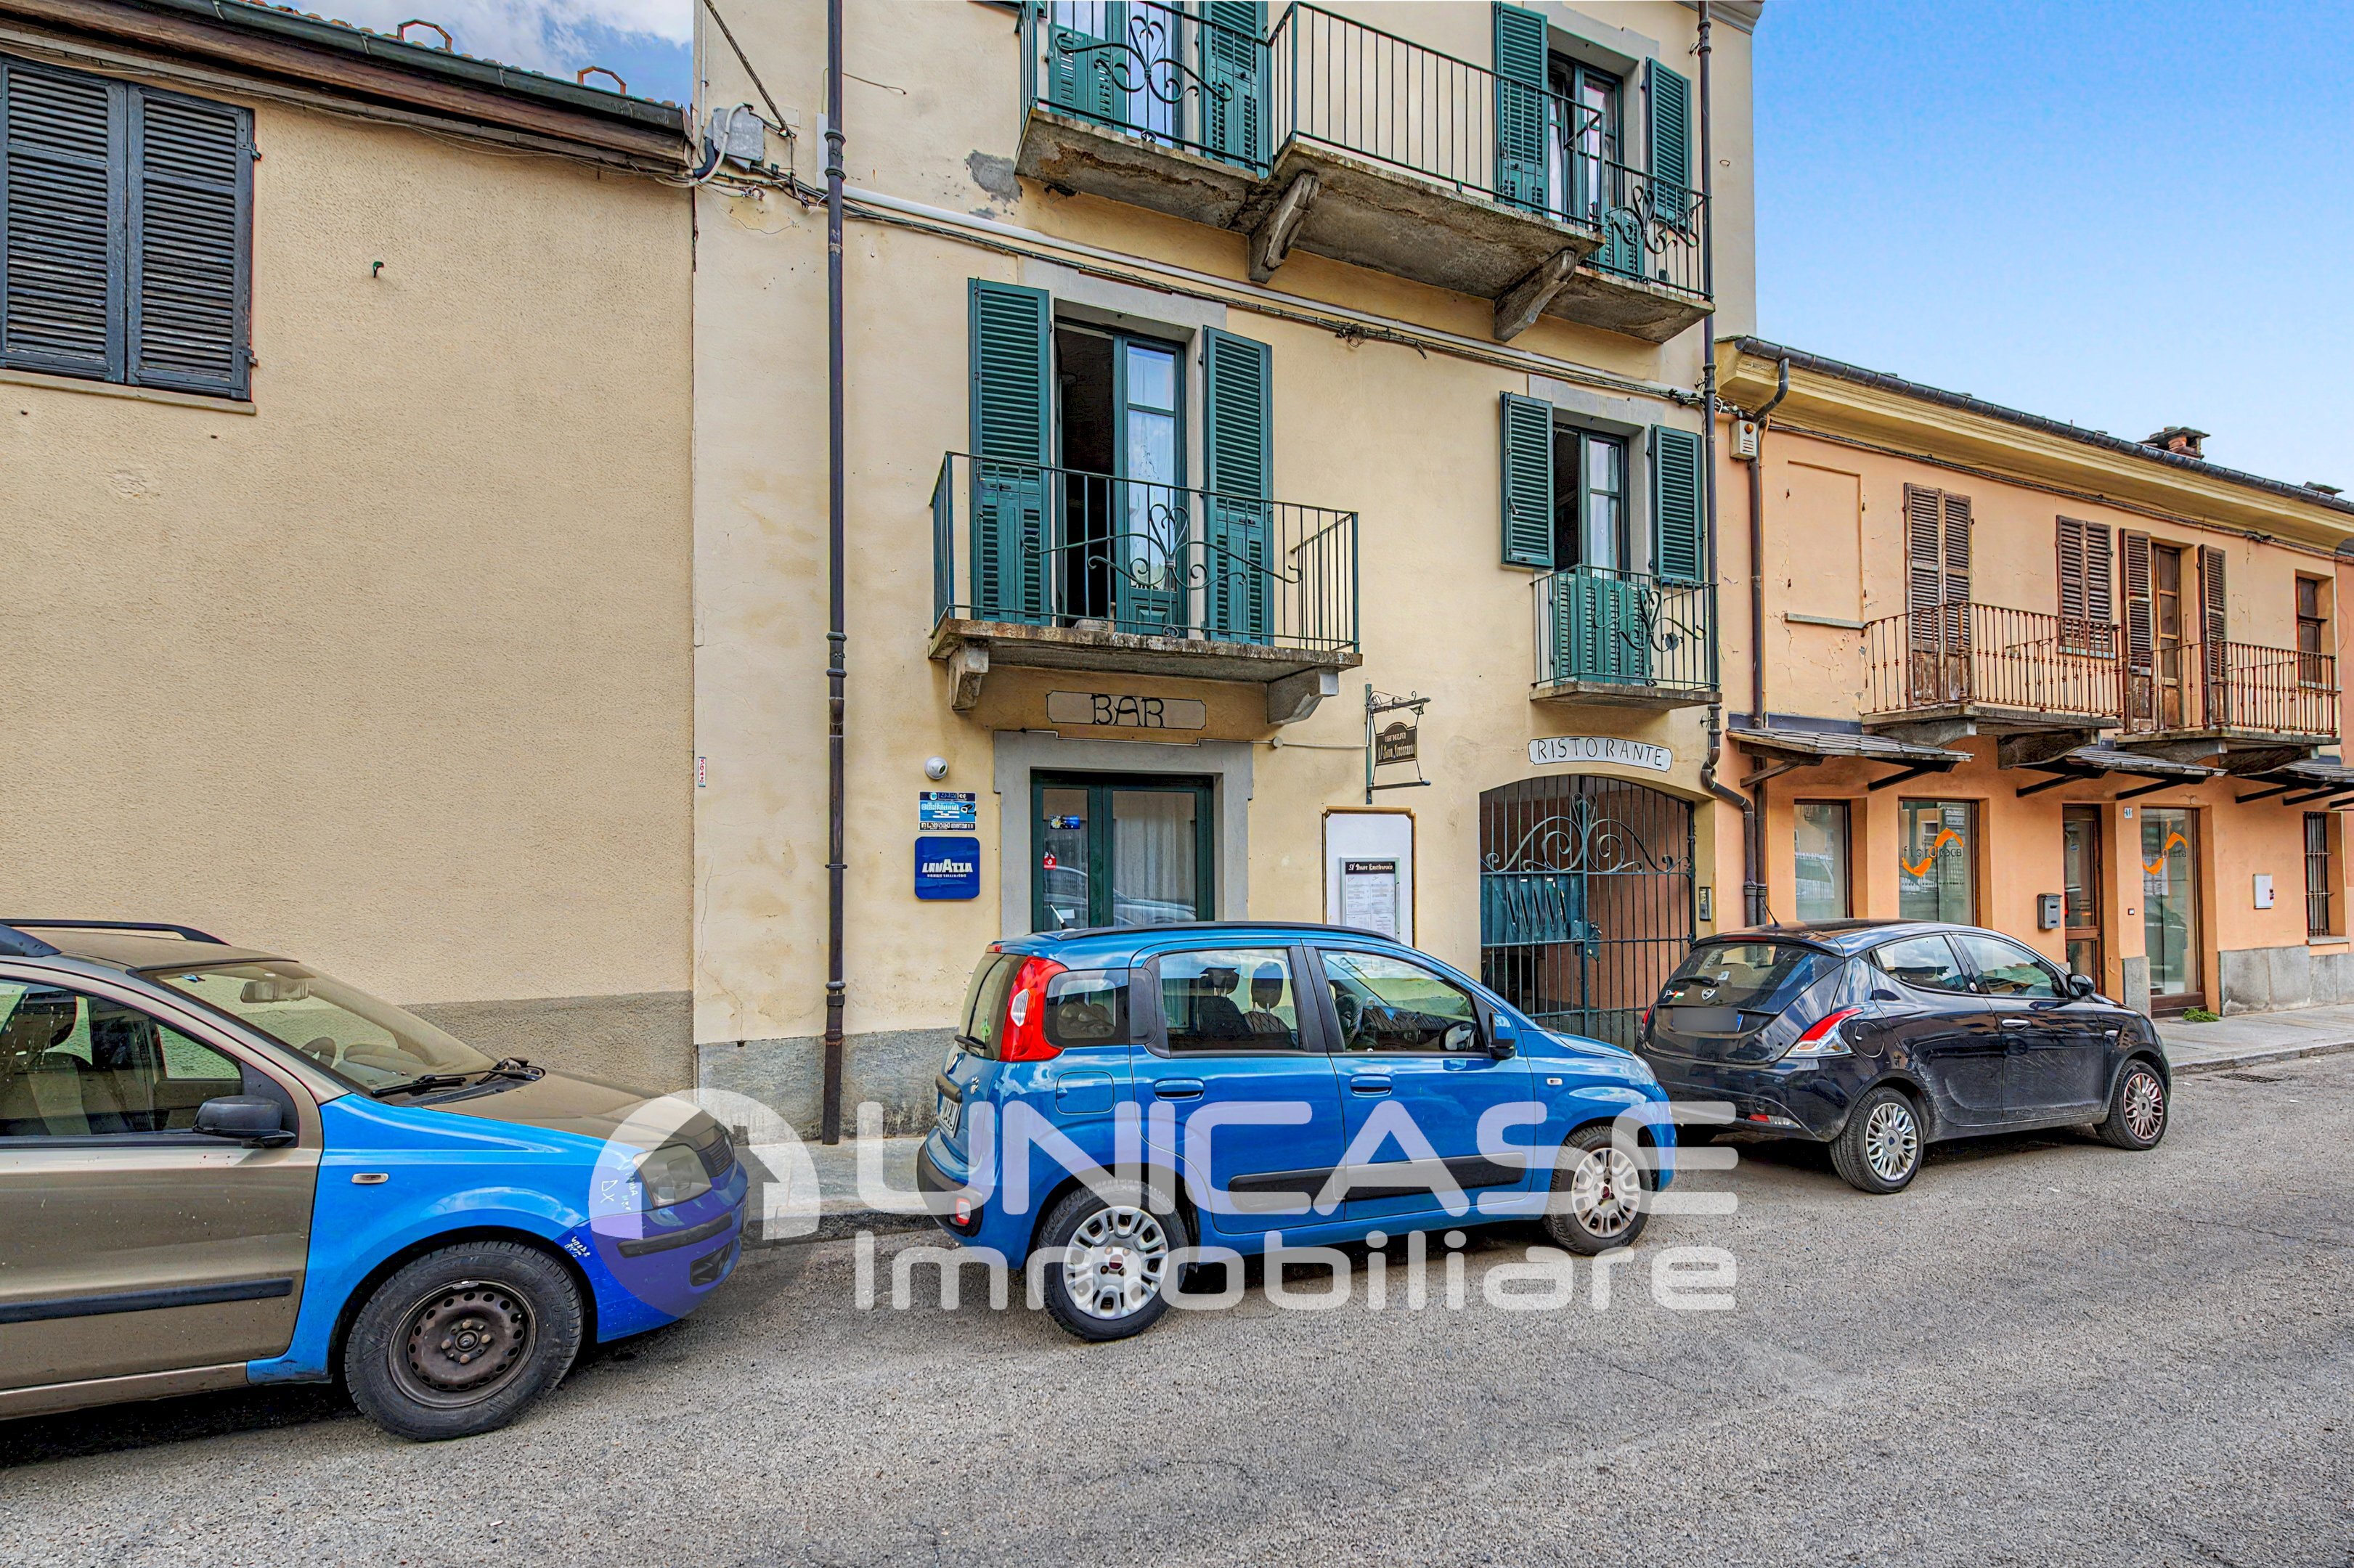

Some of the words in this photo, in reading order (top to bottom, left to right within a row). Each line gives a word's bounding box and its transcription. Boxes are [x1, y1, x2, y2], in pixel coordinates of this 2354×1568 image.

[1090, 693, 1165, 728] BAR
[1537, 738, 1664, 767] RISTORANTE
[921, 859, 973, 873] LAVAZZA
